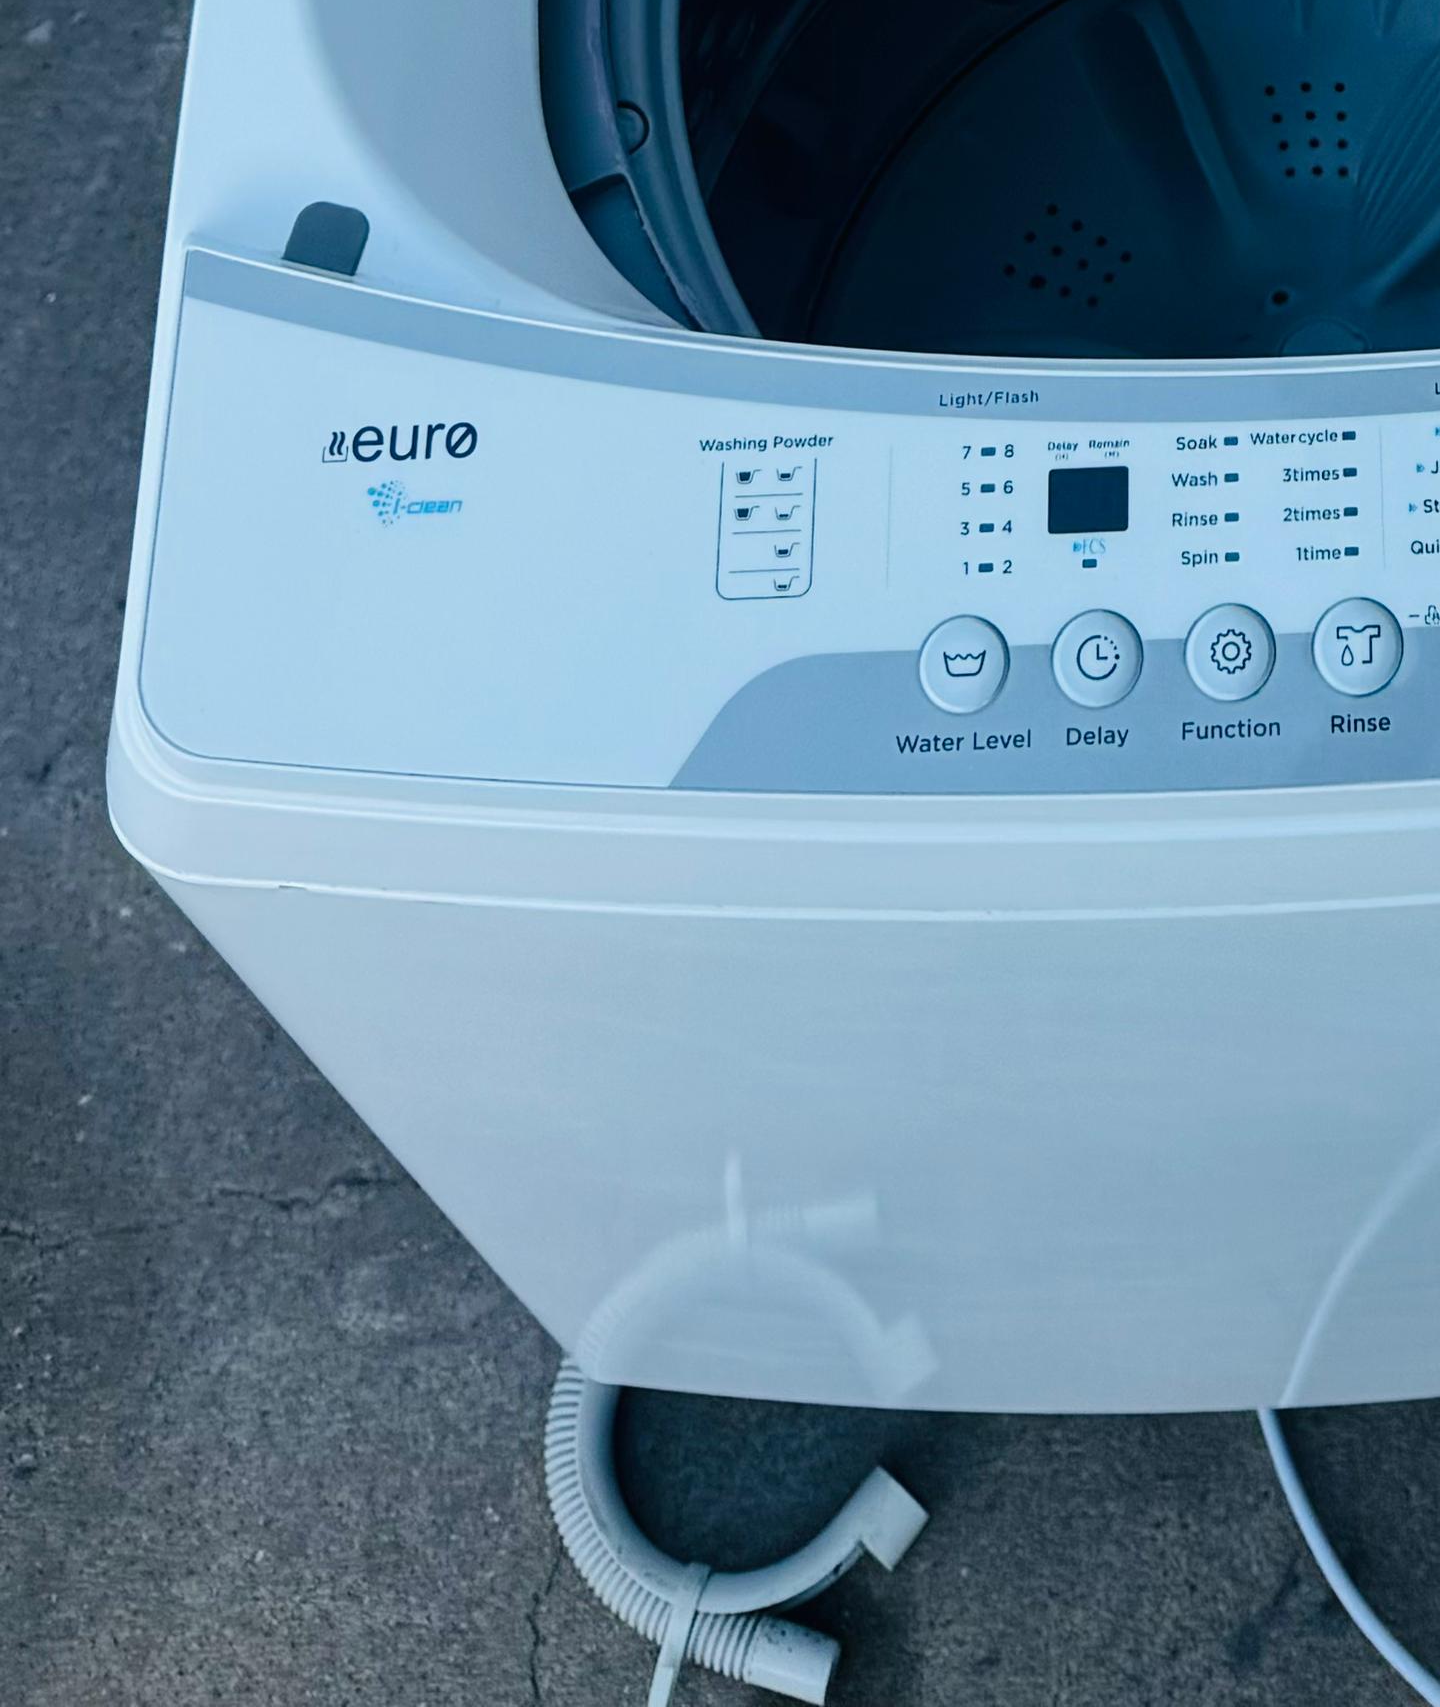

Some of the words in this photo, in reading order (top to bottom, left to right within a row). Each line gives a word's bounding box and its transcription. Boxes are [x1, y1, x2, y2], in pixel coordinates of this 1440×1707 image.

[939, 390, 1039, 409] Light/Flash
[699, 438, 768, 452] Washing
[773, 434, 834, 449] Powder
[1047, 441, 1079, 452] Delay
[1176, 434, 1217, 451] Soak
[962, 445, 972, 460] 7
[1004, 443, 1015, 459] 8
[1171, 471, 1218, 487] Wash
[1282, 468, 1340, 483] 3times
[961, 482, 971, 496] 5
[1003, 480, 1014, 495] 6
[1172, 512, 1218, 527] Rinse
[1283, 507, 1341, 522] 2times
[960, 521, 970, 536] 3
[1001, 519, 1013, 534] 4
[1181, 550, 1219, 568] Spin
[1296, 546, 1342, 561] 1time
[1002, 559, 1013, 575] 2
[1182, 718, 1281, 741] Function
[1330, 713, 1391, 734] Rinse
[895, 734, 965, 754] Water
[973, 728, 1031, 751] Level
[1066, 725, 1129, 748] Delay
